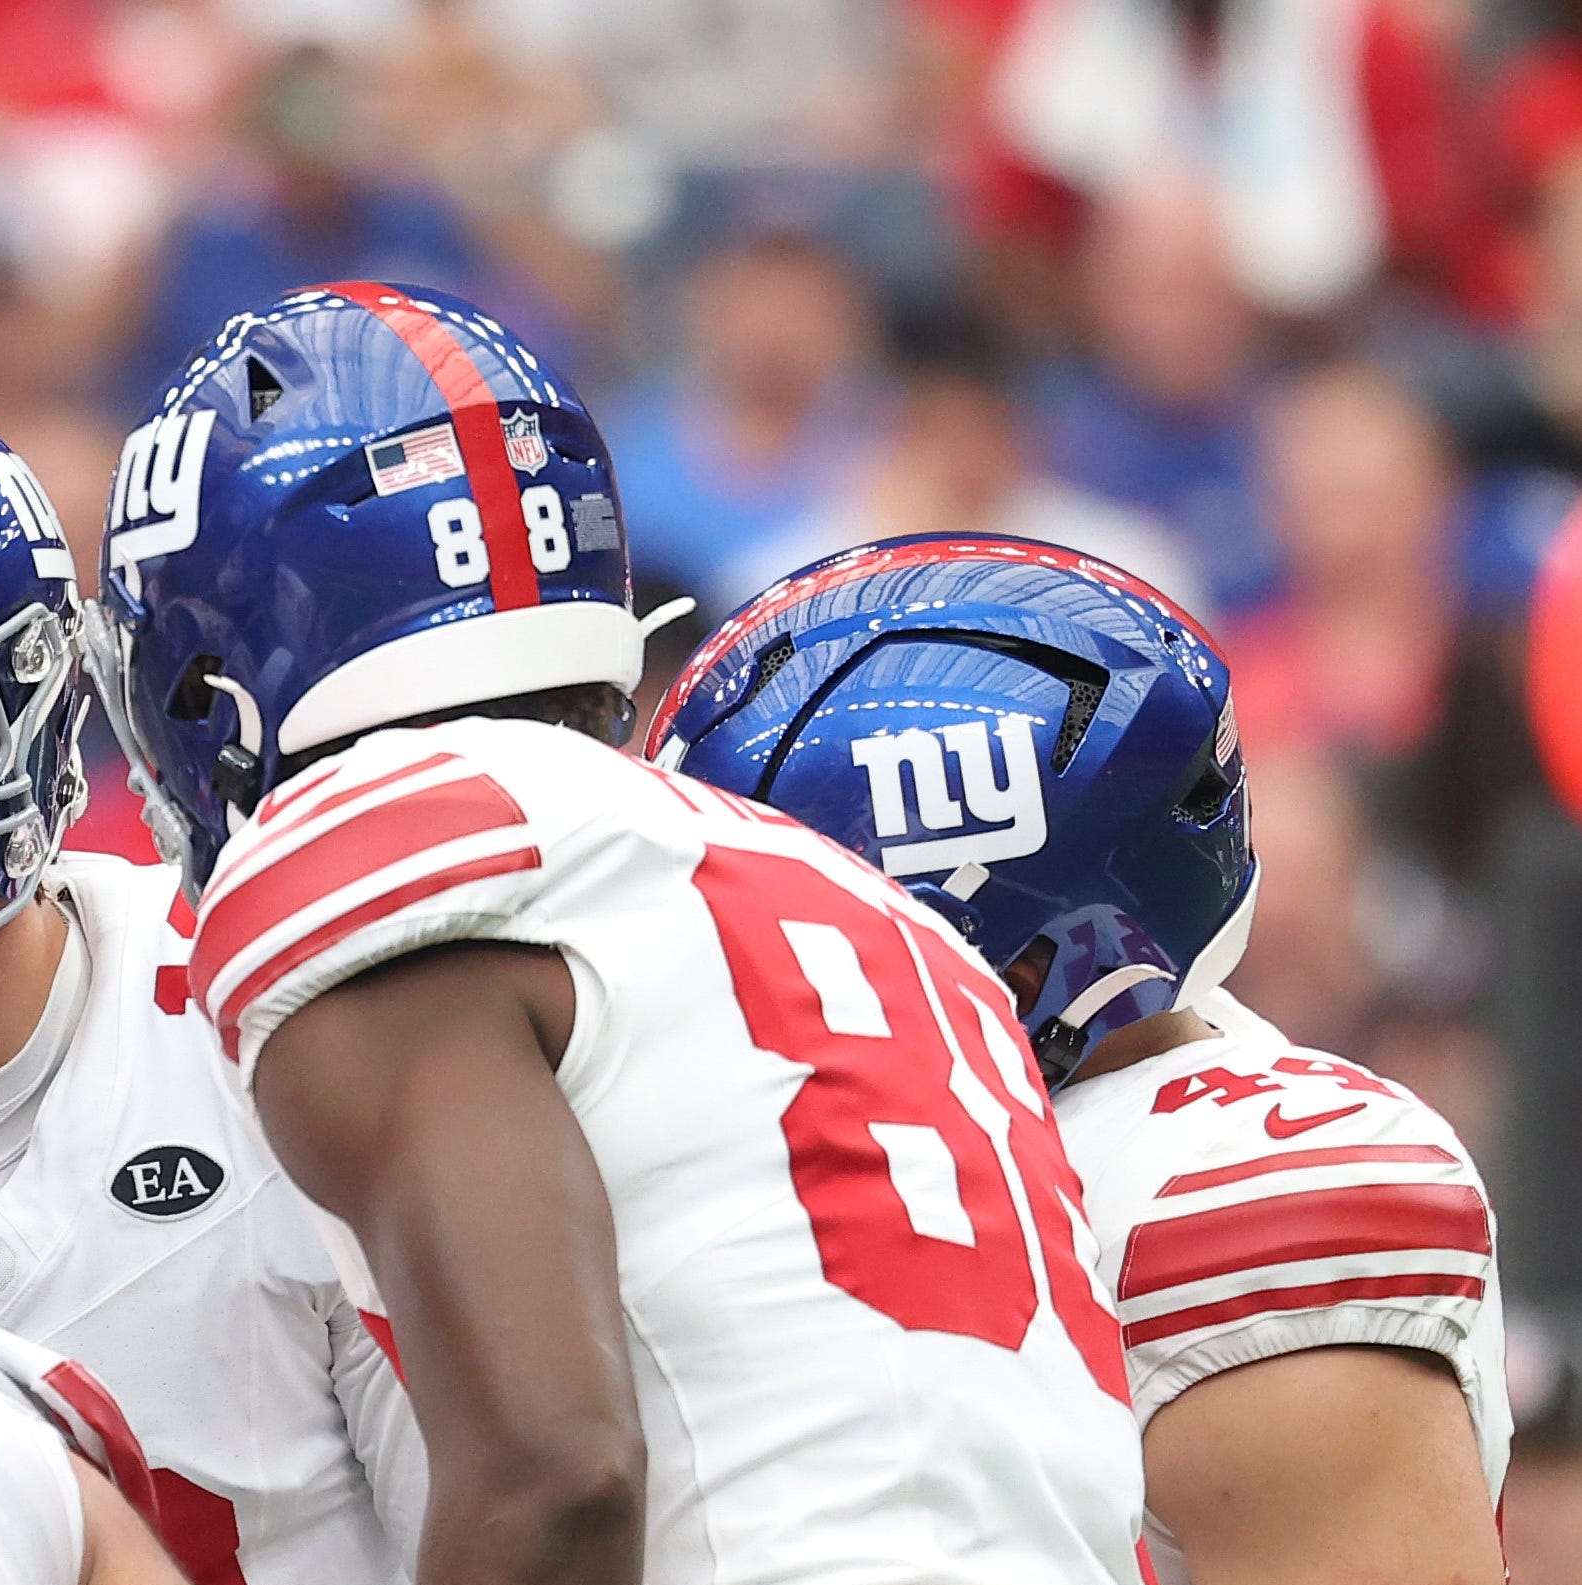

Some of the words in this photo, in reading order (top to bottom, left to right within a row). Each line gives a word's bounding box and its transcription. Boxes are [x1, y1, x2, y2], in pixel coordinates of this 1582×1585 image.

[510, 436, 544, 466] NFL
[427, 484, 572, 590] 88
[850, 709, 1048, 878] ny
[126, 1156, 211, 1206] EA
